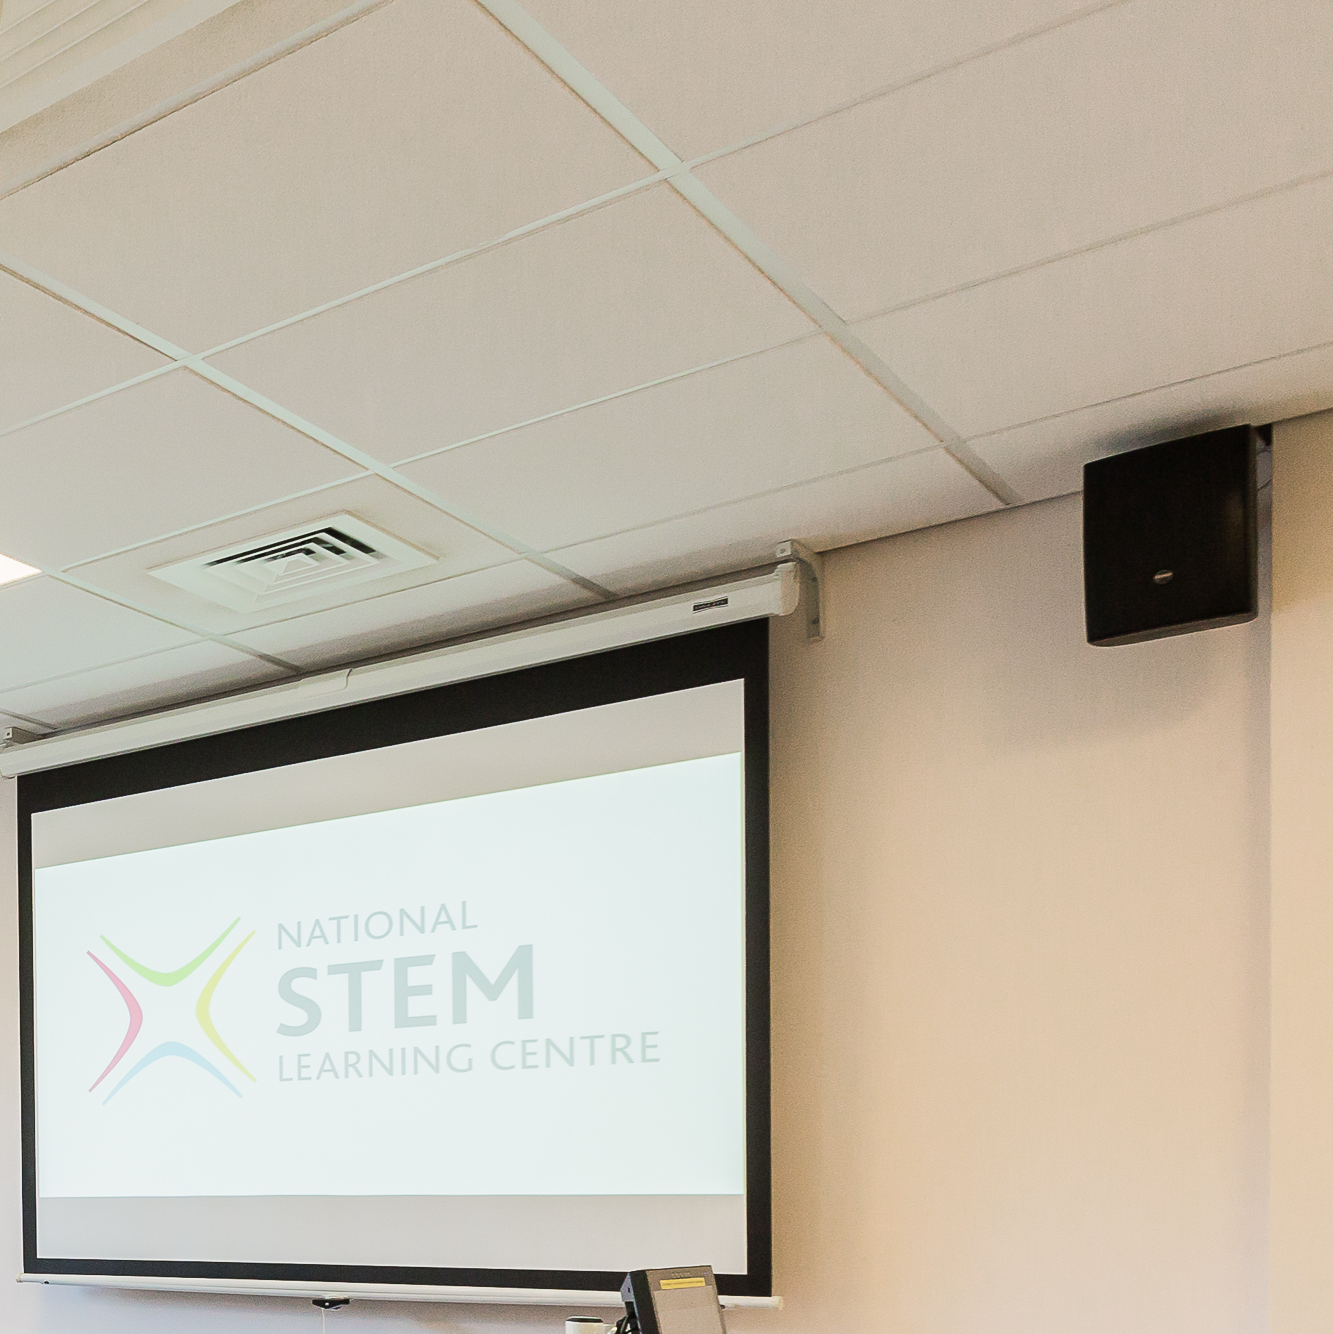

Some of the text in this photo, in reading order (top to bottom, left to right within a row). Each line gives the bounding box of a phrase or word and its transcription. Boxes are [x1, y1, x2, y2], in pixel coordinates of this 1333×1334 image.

[277, 900, 478, 950] NATIONAL
[276, 944, 534, 1037] STEM
[278, 1031, 661, 1082] LEARNING CENTRE
